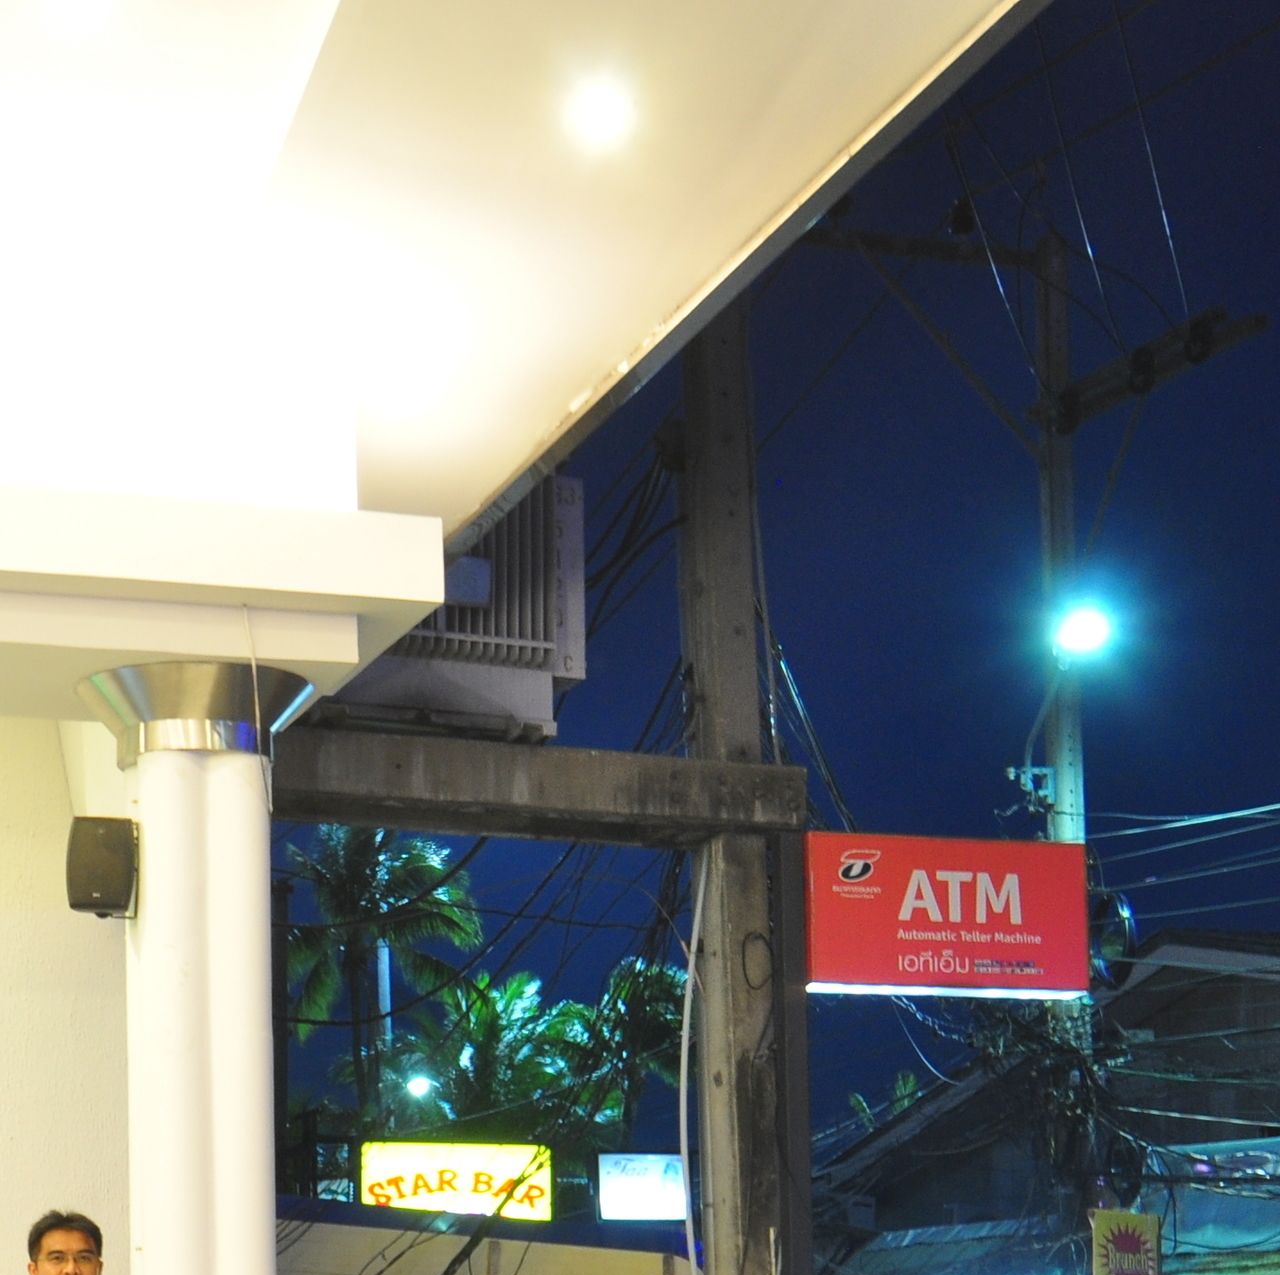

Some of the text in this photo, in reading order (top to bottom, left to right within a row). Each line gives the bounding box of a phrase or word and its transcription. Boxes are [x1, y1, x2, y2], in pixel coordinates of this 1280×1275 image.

[897, 869, 1022, 925] ATM
[897, 928, 1042, 945] Automatic Teller Machine
[898, 949, 970, 974] เอทีเอ็ม
[368, 1169, 545, 1208] STAR BAR
[1108, 1244, 1150, 1271] Brunch
